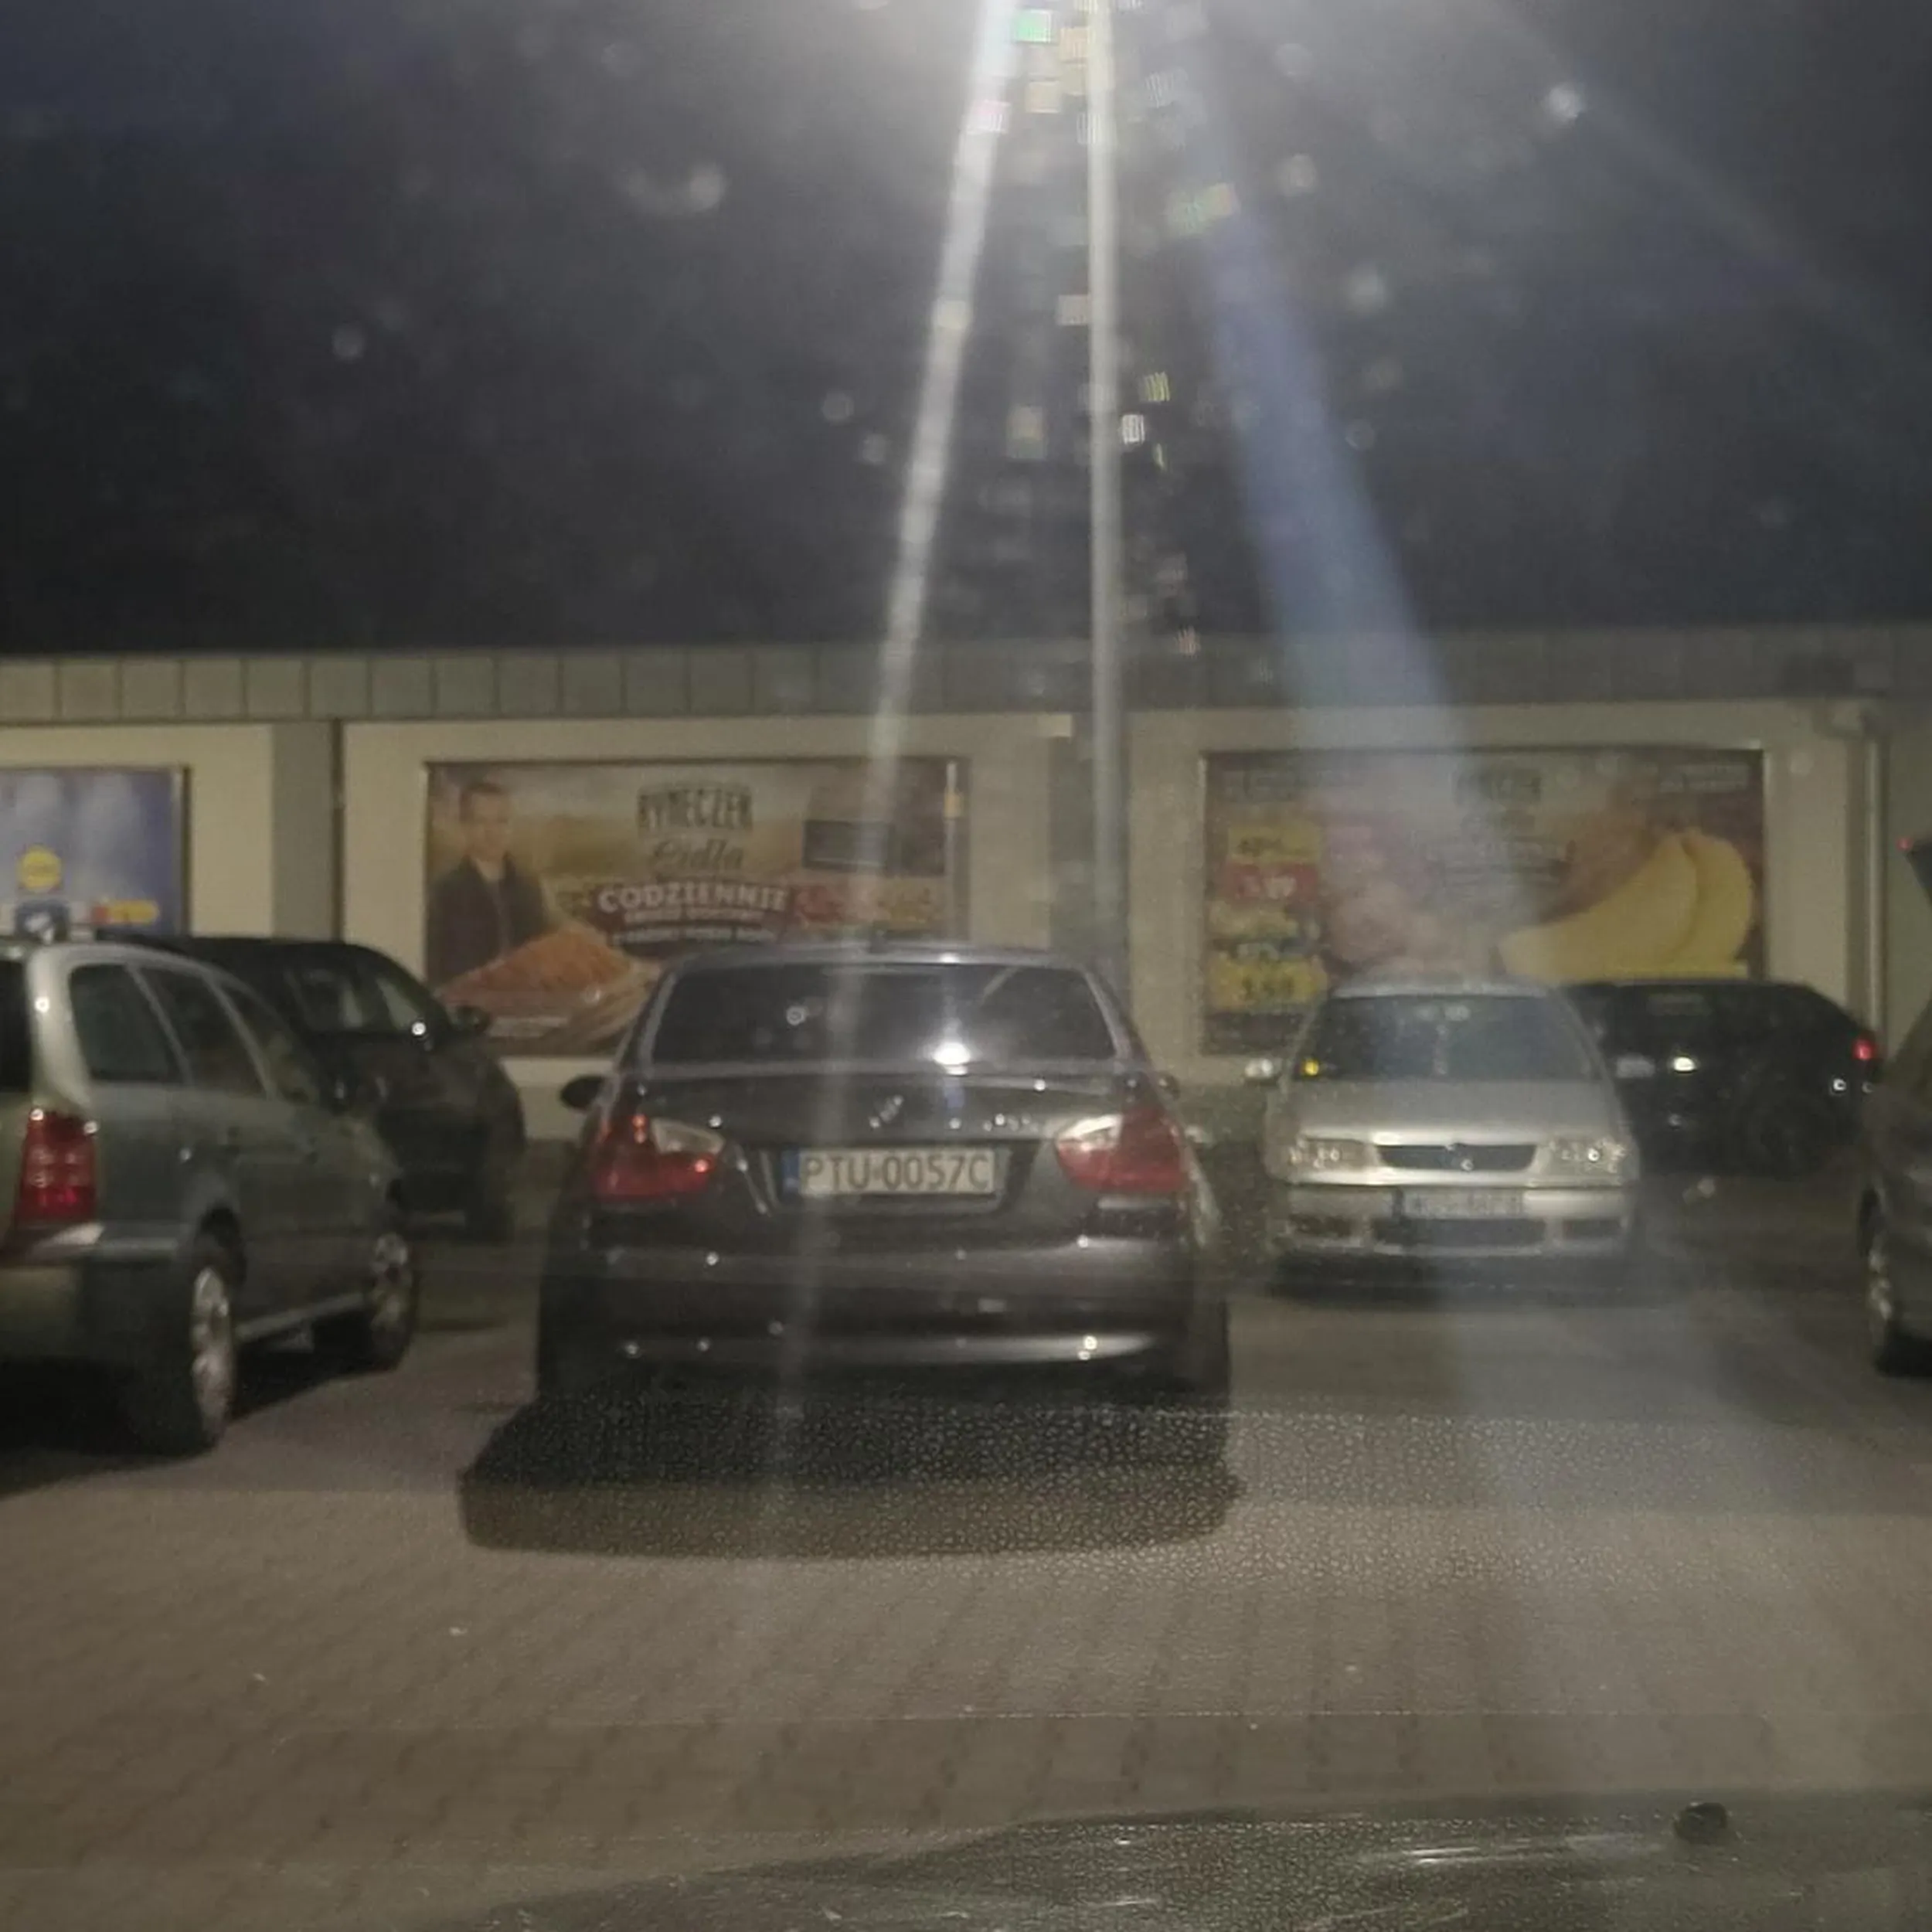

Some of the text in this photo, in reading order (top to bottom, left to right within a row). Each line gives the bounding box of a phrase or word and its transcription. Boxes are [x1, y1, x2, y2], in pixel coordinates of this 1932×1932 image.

[597, 881, 787, 913] CODZIENNIE
[802, 1155, 991, 1191] PTU 0057C
